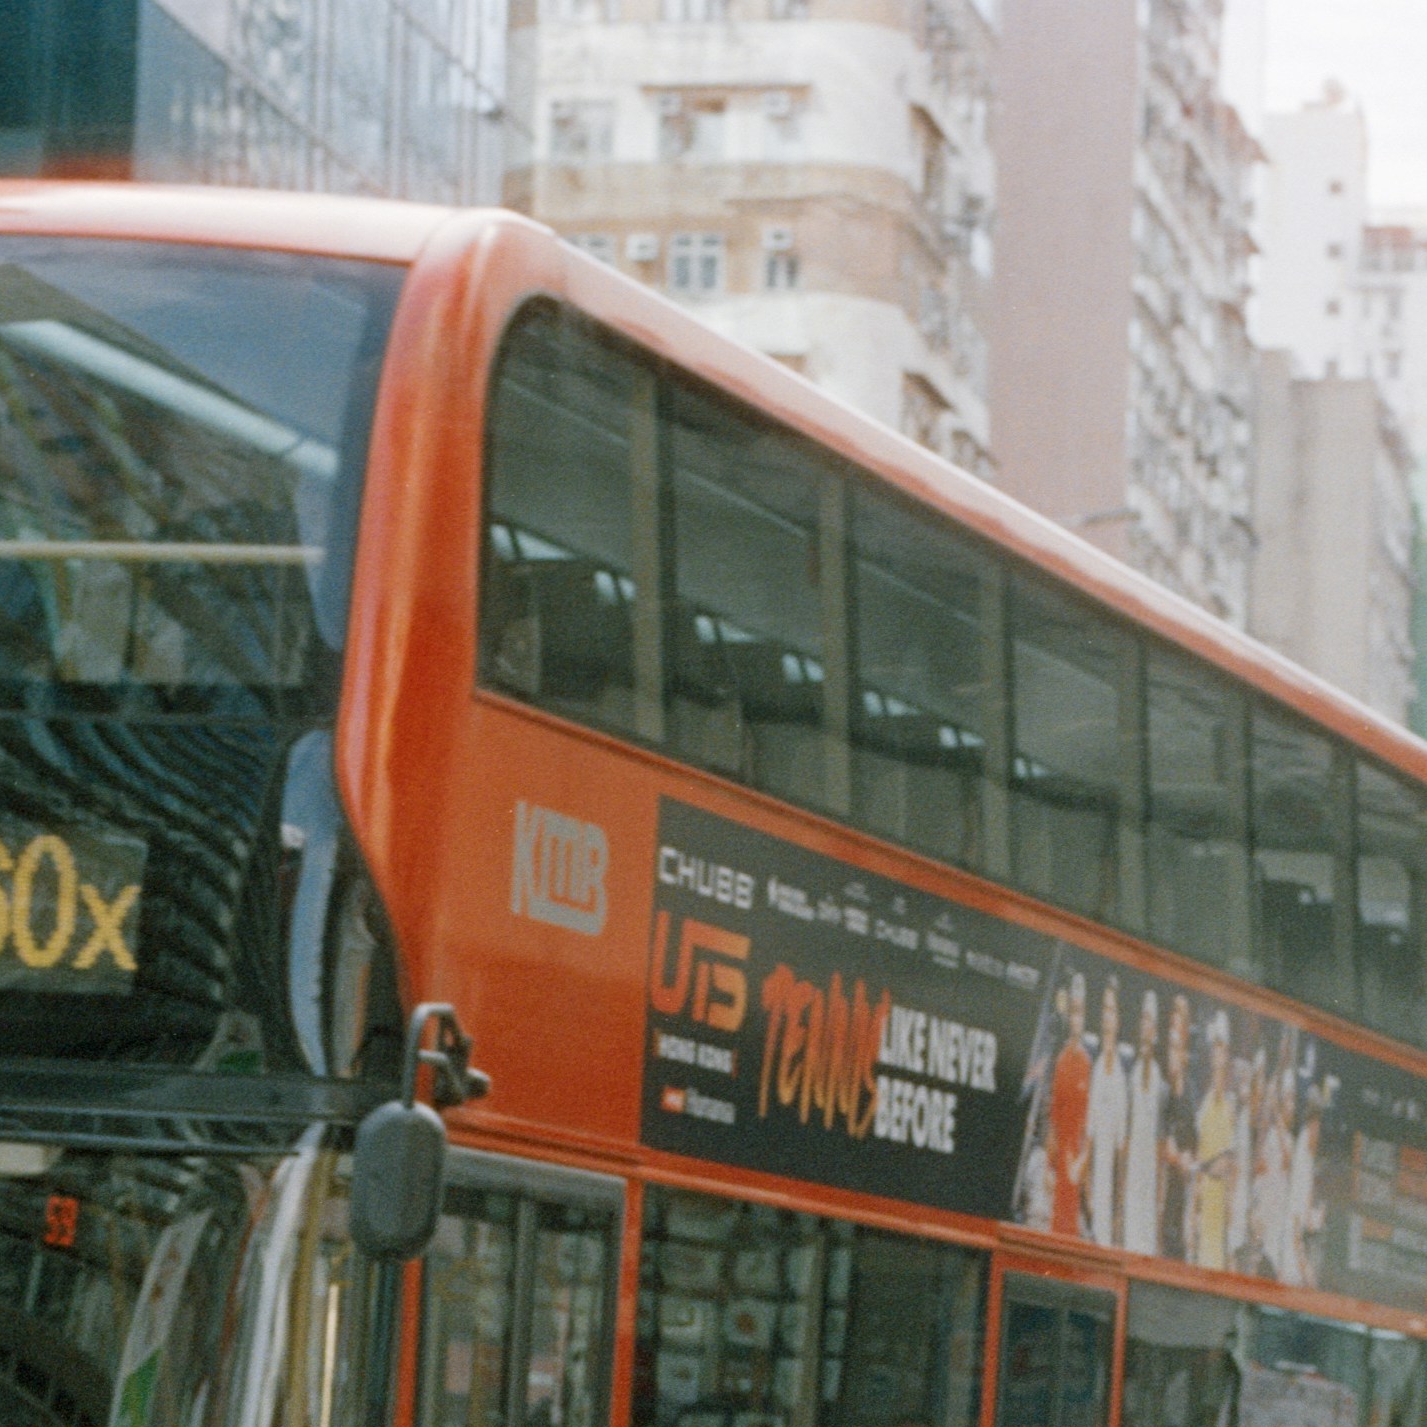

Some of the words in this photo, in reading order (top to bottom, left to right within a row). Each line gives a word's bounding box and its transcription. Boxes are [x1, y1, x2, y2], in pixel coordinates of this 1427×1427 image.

[510, 799, 609, 937] KMB
[657, 845, 754, 911] CHUBB
[879, 1004, 926, 1073] LIKE
[927, 1013, 998, 1094] NEVER
[874, 1075, 958, 1154] BEFORE
